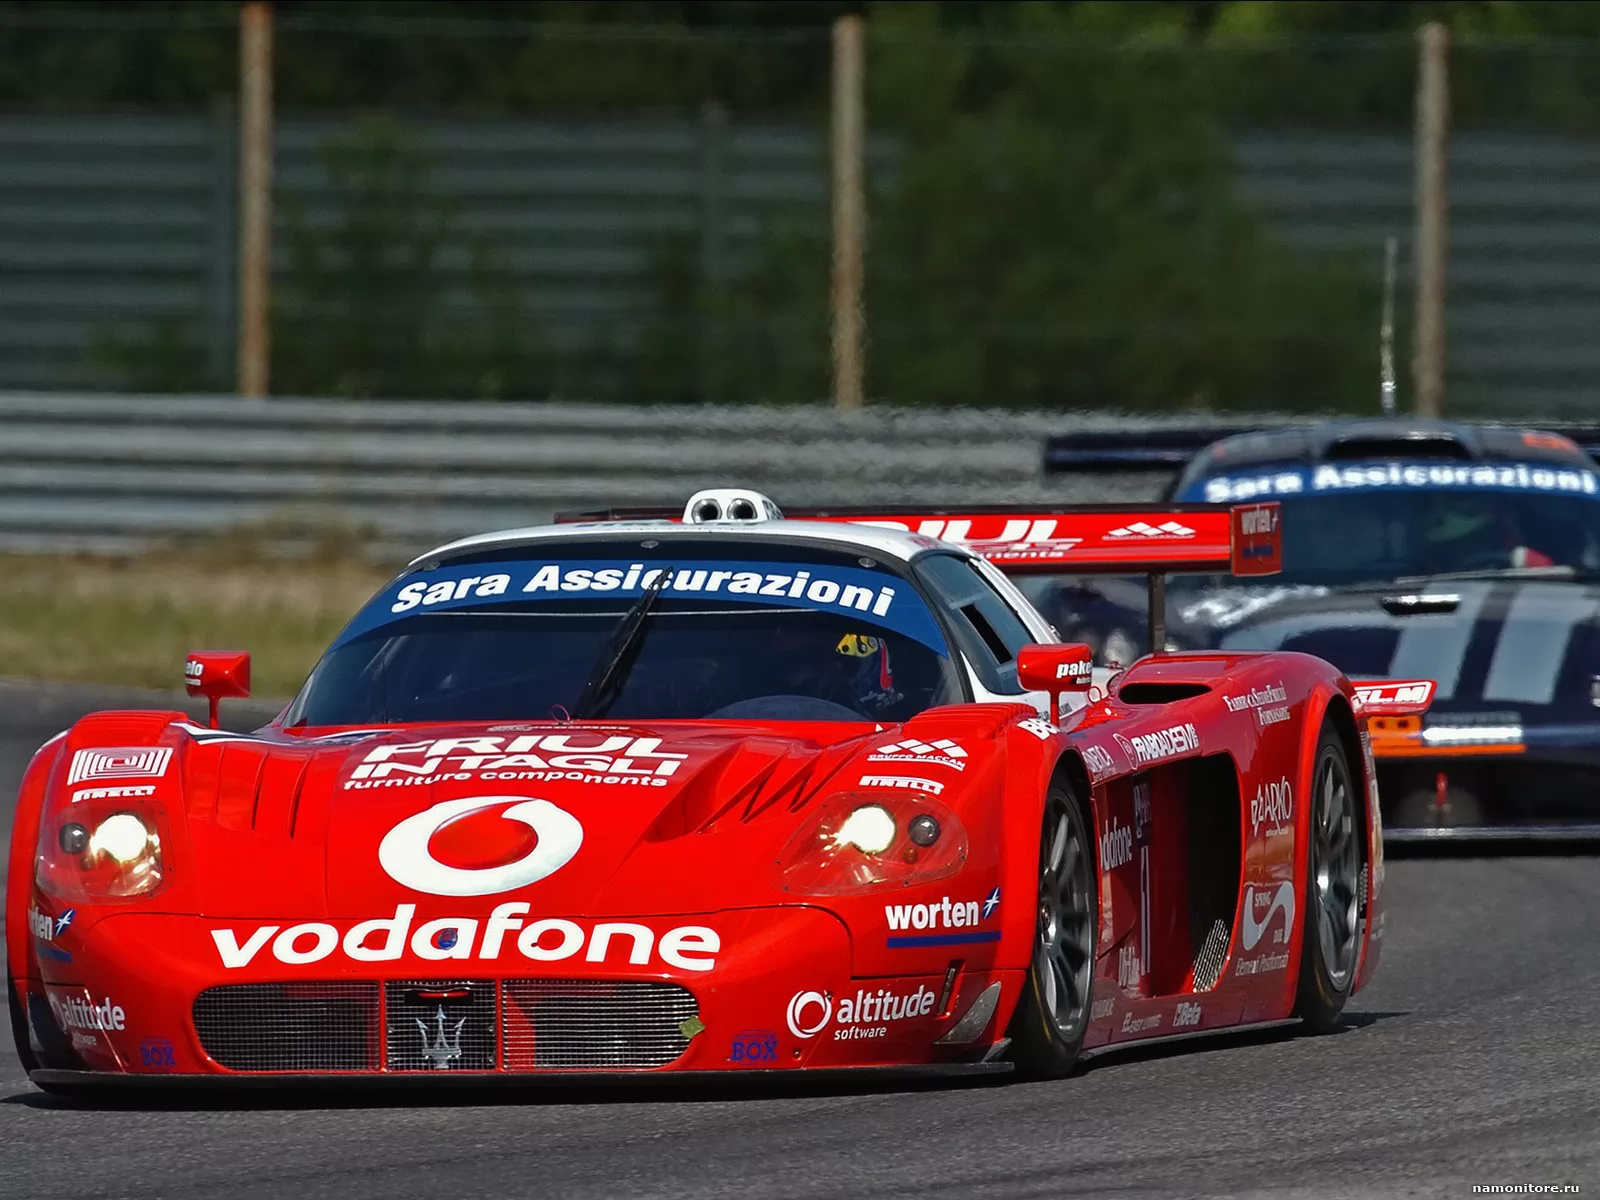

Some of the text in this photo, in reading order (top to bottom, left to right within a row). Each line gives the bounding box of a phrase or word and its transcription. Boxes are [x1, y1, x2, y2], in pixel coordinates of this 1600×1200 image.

[1205, 463, 1598, 502] Sara Assicurazioni
[391, 563, 896, 618] Sara Assicurazioni
[185, 660, 204, 677] elo
[1056, 660, 1092, 679] pake
[1017, 718, 1061, 740] BB
[363, 734, 690, 764] FRIUL
[350, 753, 682, 779] INTAGLI
[344, 767, 669, 790] furniture components
[859, 775, 945, 795] PIRELLI
[885, 896, 979, 931] worten
[210, 901, 722, 972] vodafone
[61, 995, 126, 1031] altitude
[836, 984, 936, 1024] altitude
[834, 1025, 888, 1041] software
[140, 1045, 177, 1067] BOX
[730, 1040, 779, 1062] BOX
